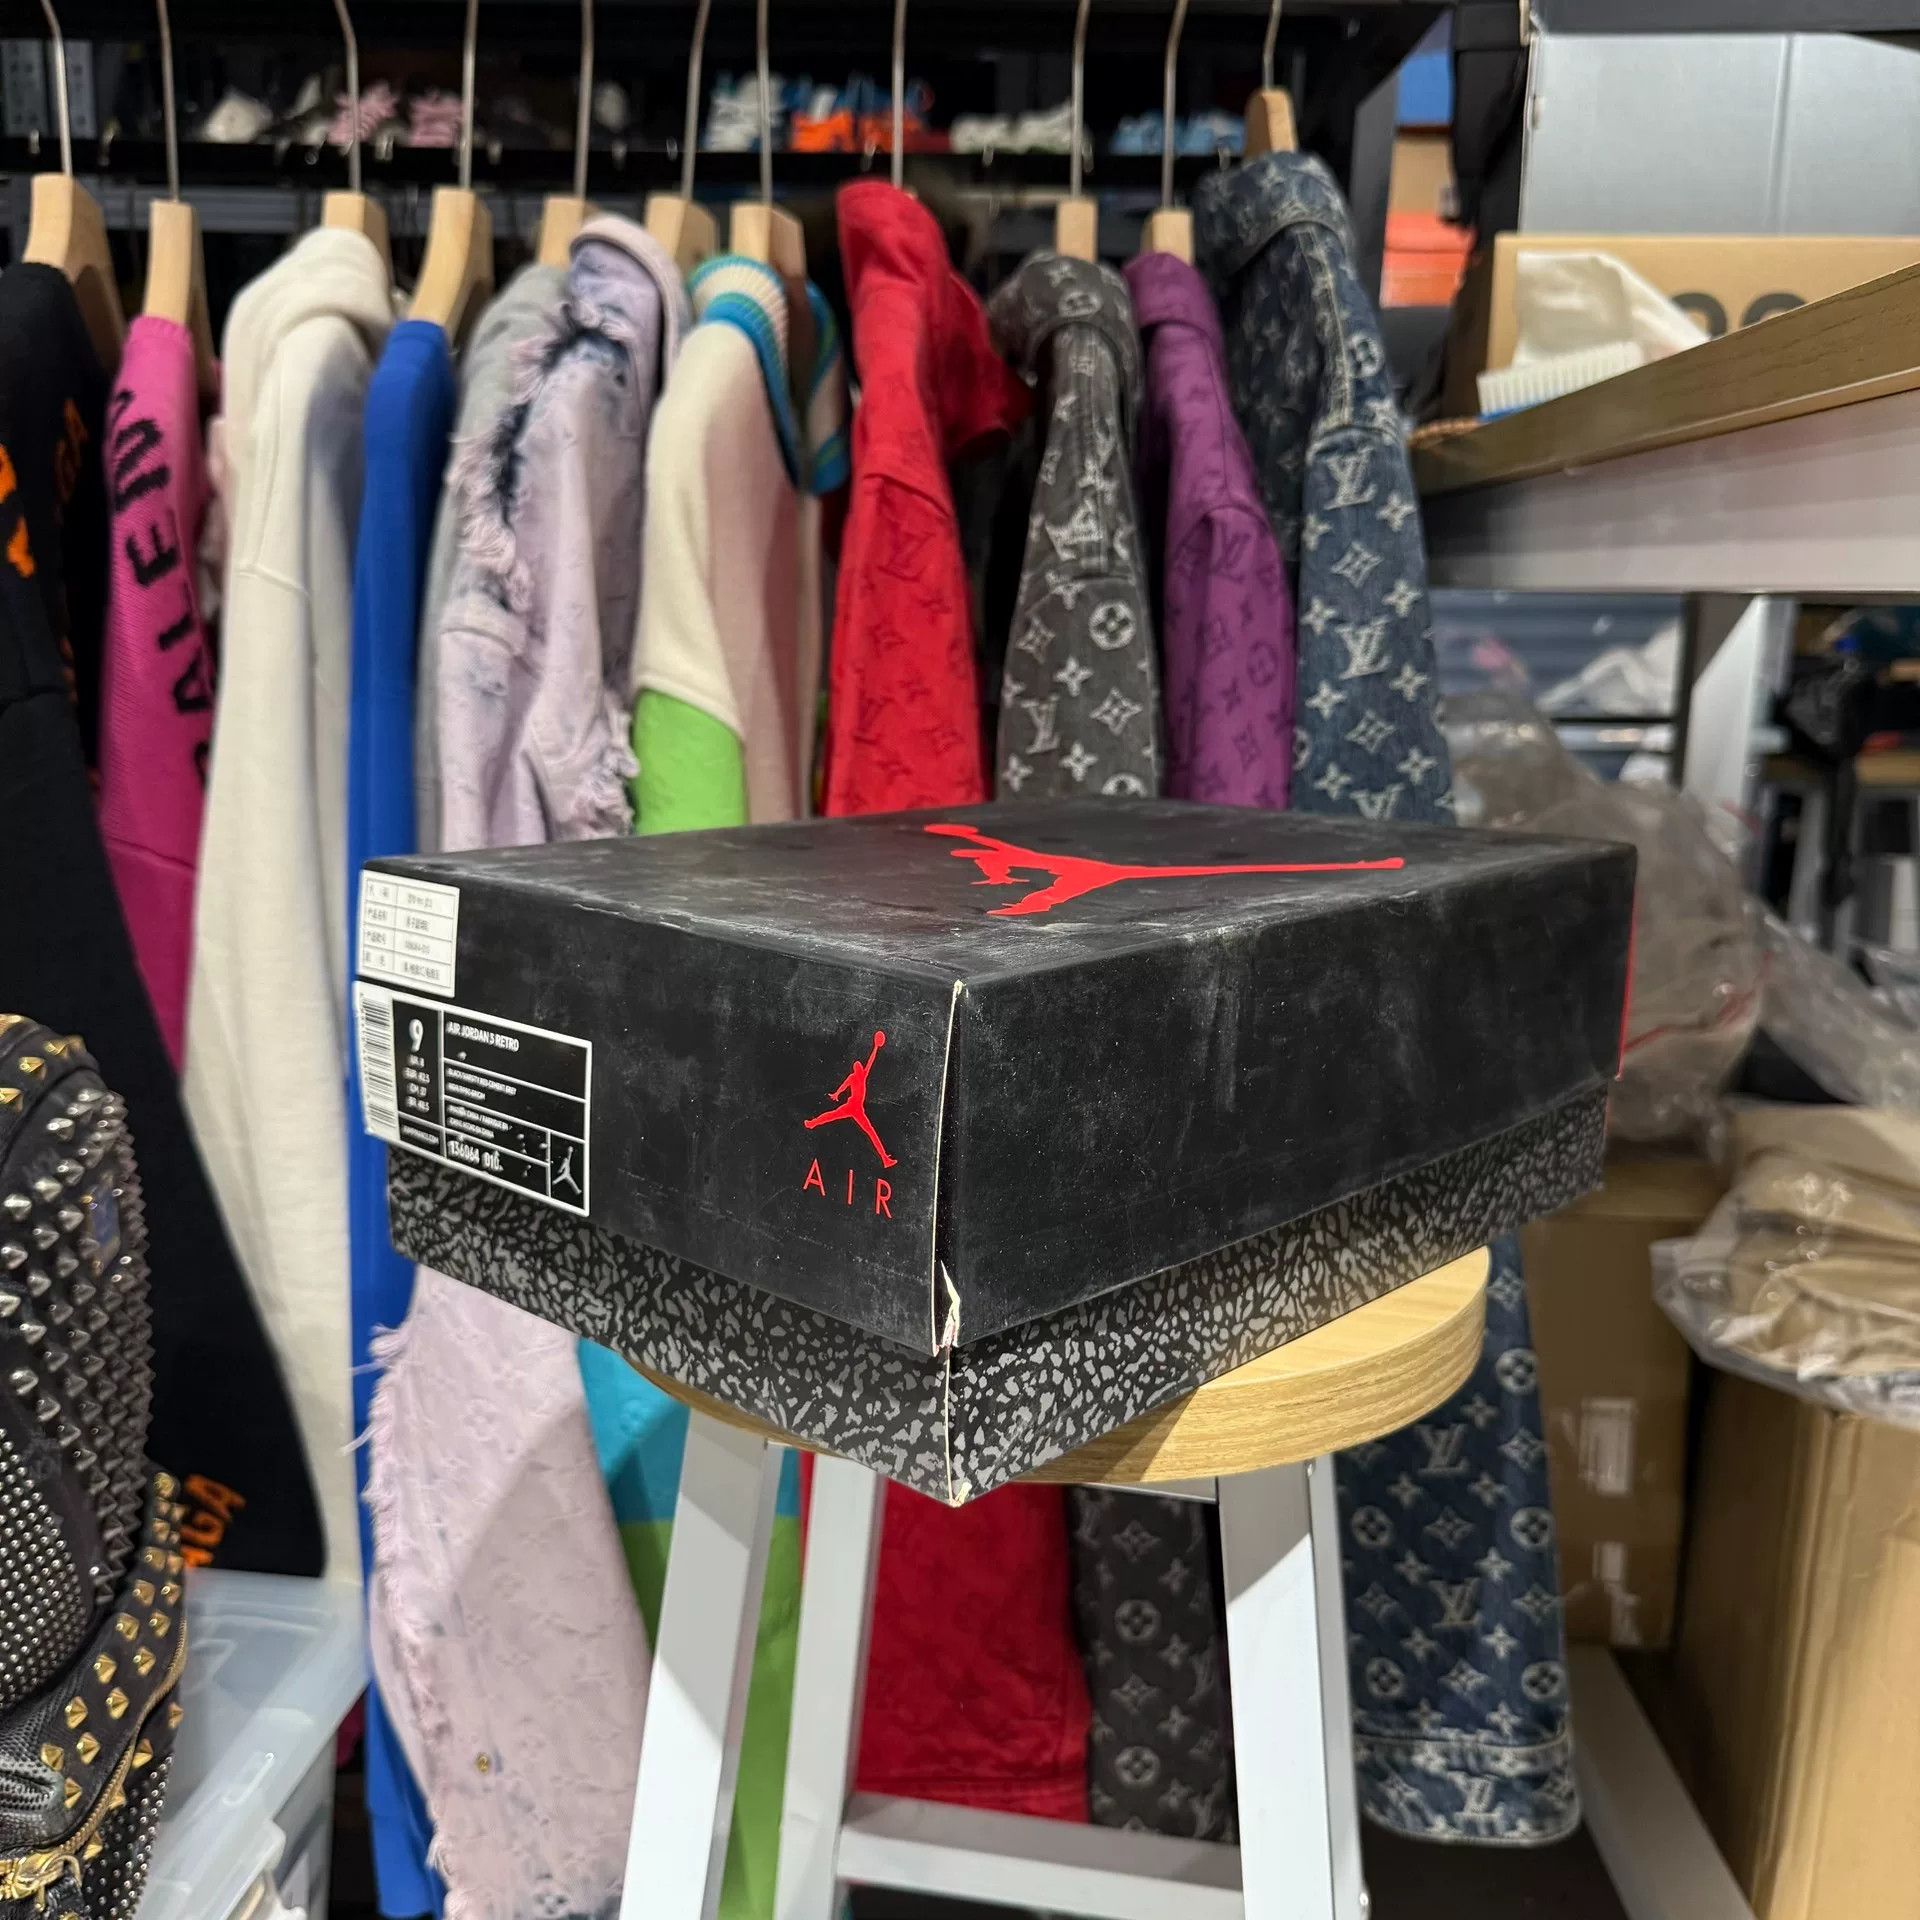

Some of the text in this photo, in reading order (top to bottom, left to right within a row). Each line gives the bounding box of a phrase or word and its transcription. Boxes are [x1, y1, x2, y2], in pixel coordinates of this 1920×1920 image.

[409, 1019, 424, 1053] 9
[446, 1020, 461, 1036] AIR
[461, 1024, 490, 1044] JORDAN
[495, 1033, 520, 1052] RETRO
[803, 1158, 894, 1220] AIR
